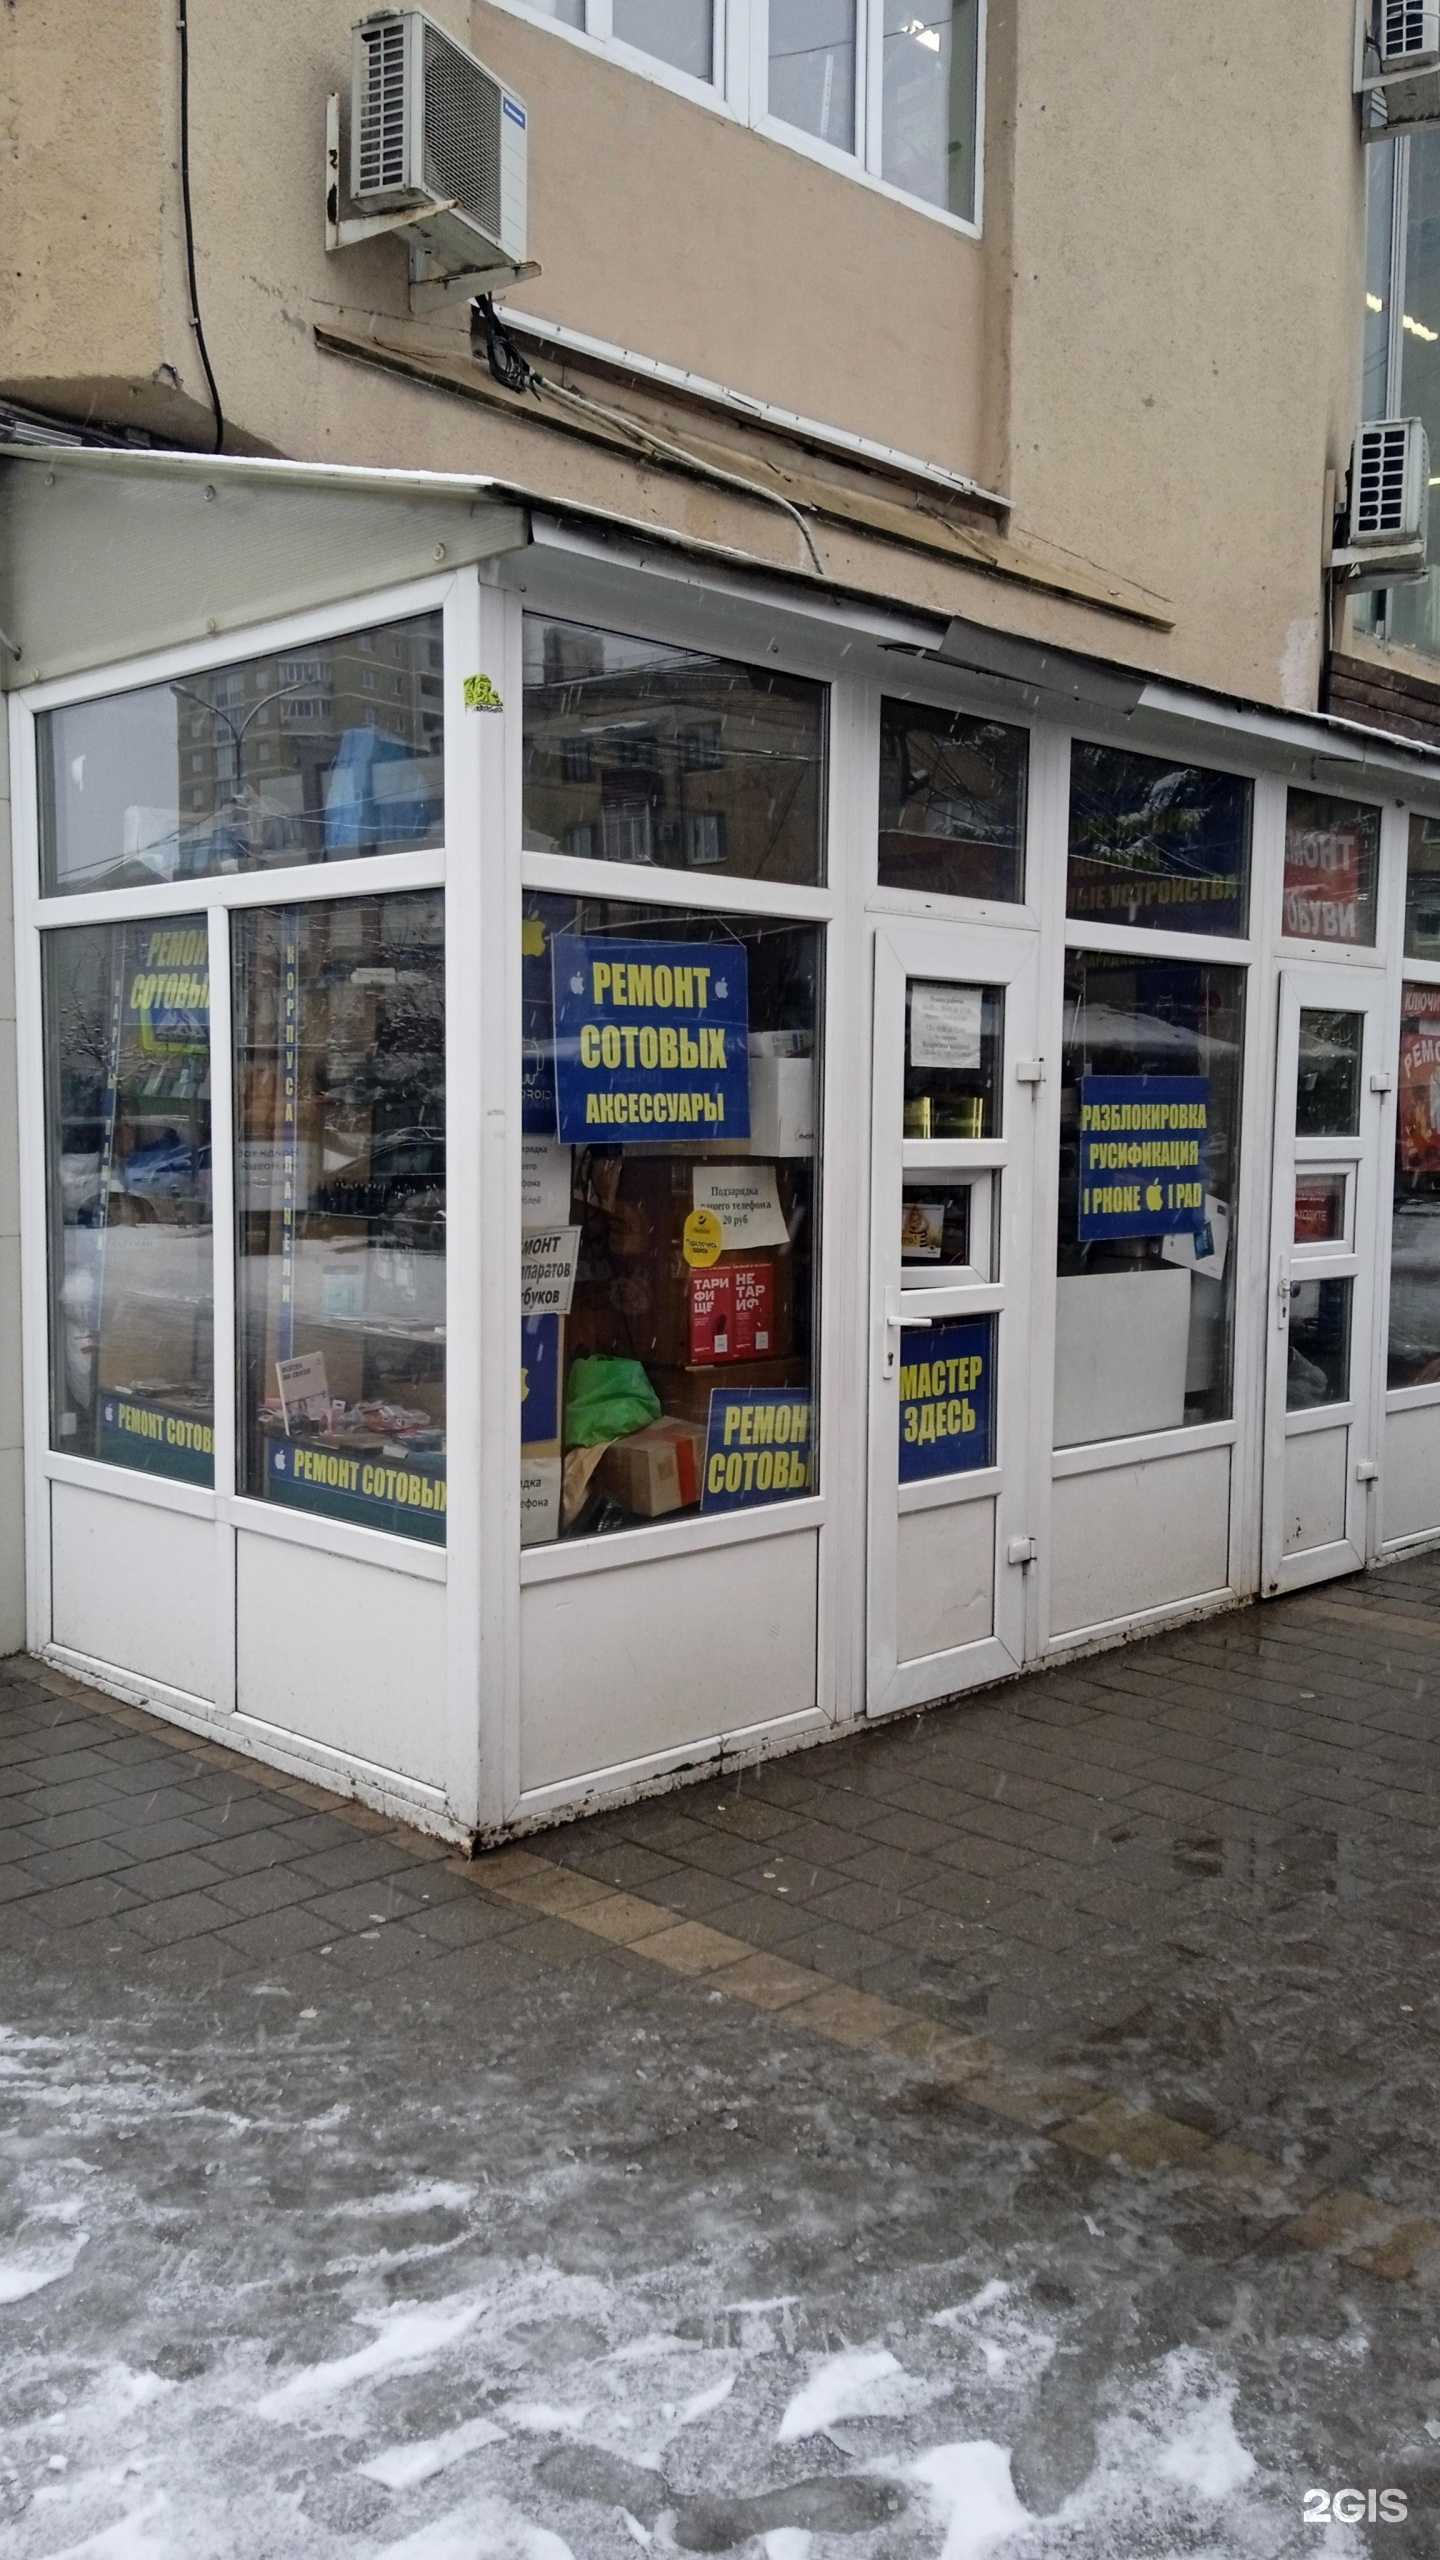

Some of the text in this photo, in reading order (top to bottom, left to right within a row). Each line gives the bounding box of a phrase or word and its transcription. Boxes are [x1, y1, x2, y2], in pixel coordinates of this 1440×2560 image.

[1286, 893, 1356, 937] ОБУВИ
[592, 961, 711, 1008] РЕМОНТ
[580, 1024, 727, 1069] СОТОВЫХ
[585, 1092, 725, 1124] АКСЕССУАРЫ
[1082, 1104, 1208, 1131] РАЗБЛОКИРОВКА
[1089, 1141, 1199, 1170] РУСИФИКАЦИЯ
[1092, 1186, 1141, 1214] PHONE
[1176, 1183, 1202, 1208] PAD
[693, 1278, 730, 1291] ТАРИ
[735, 1272, 756, 1286] НЕ
[735, 1285, 766, 1298] ТАР
[693, 1290, 715, 1302] ФИ
[901, 1356, 983, 1401] МАСТЕР
[118, 1402, 214, 1455] РЕМОНТ СОТОВ
[904, 1399, 977, 1446] ЗДЕСЬ
[293, 1448, 360, 1491] РЕМОНТ
